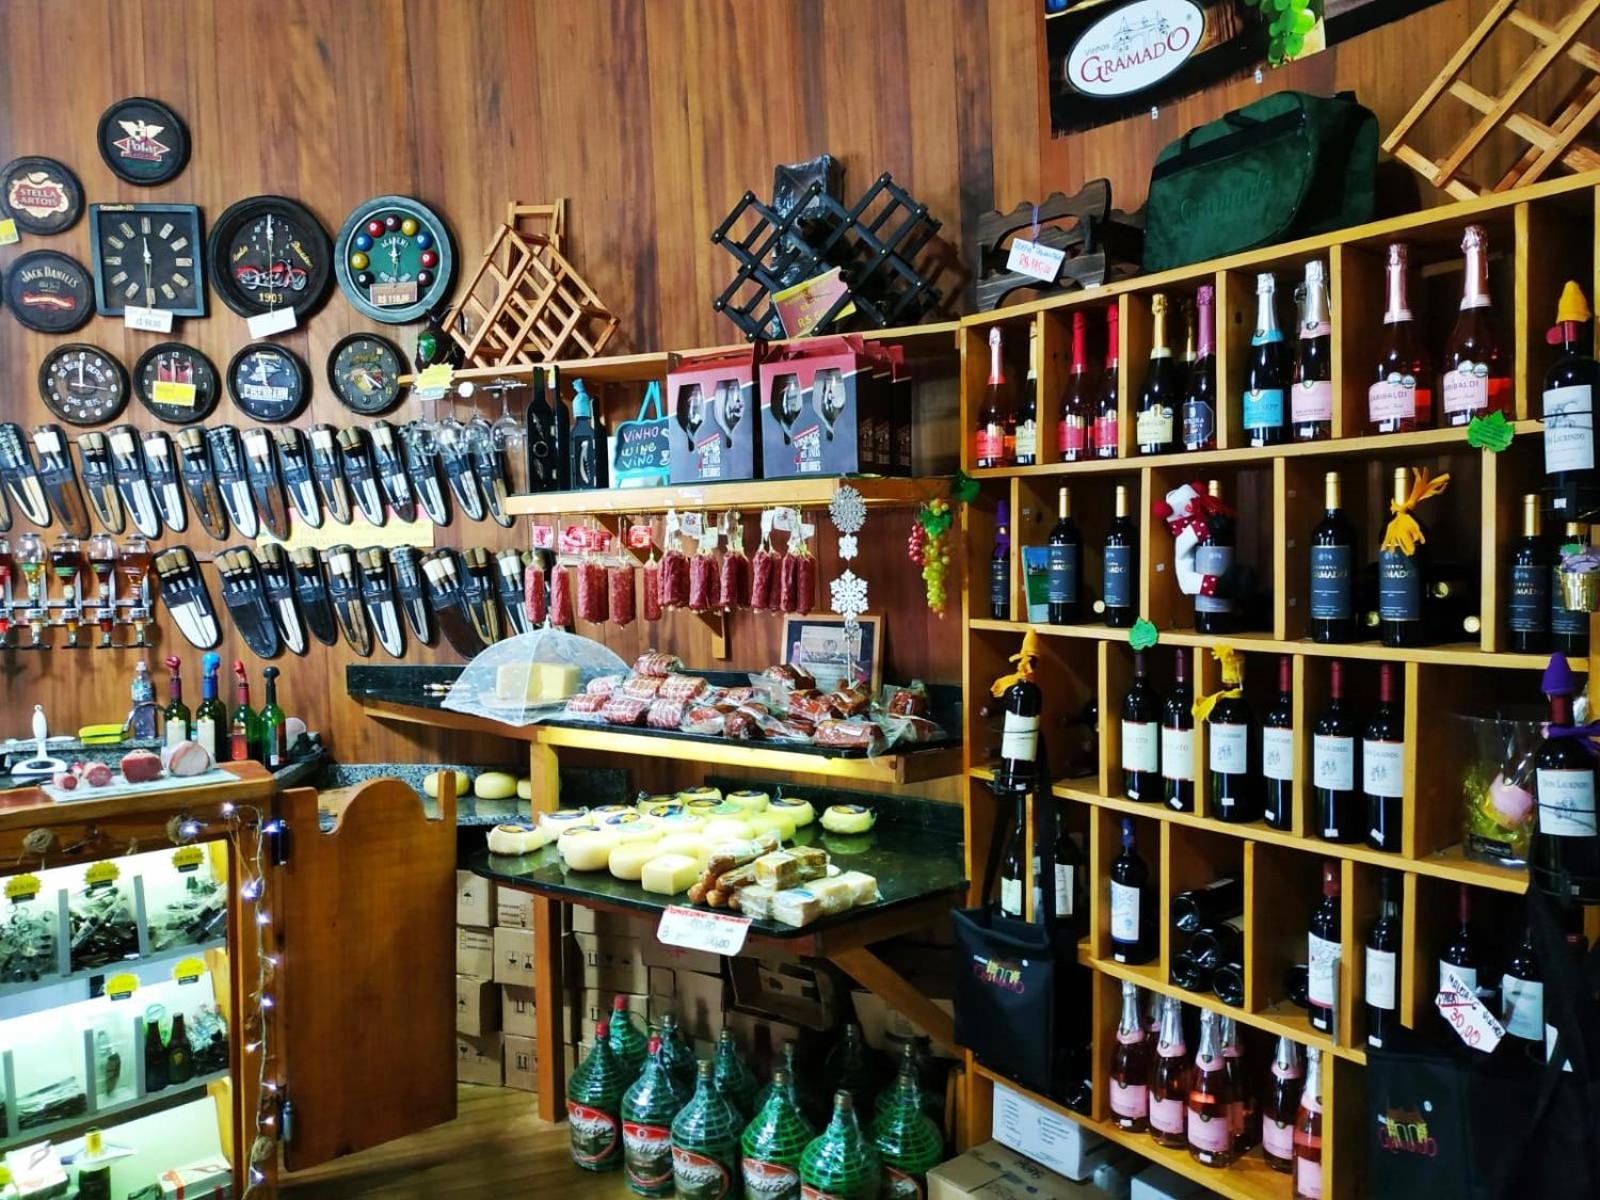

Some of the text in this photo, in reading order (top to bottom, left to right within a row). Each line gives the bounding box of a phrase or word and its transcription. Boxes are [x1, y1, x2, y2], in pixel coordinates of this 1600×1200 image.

[1080, 26, 1190, 82] GRAMADO
[20, 189, 57, 200] STELLA
[20, 197, 58, 207] ARTOIS
[21, 269, 43, 283] JACK
[259, 292, 284, 304] 1903
